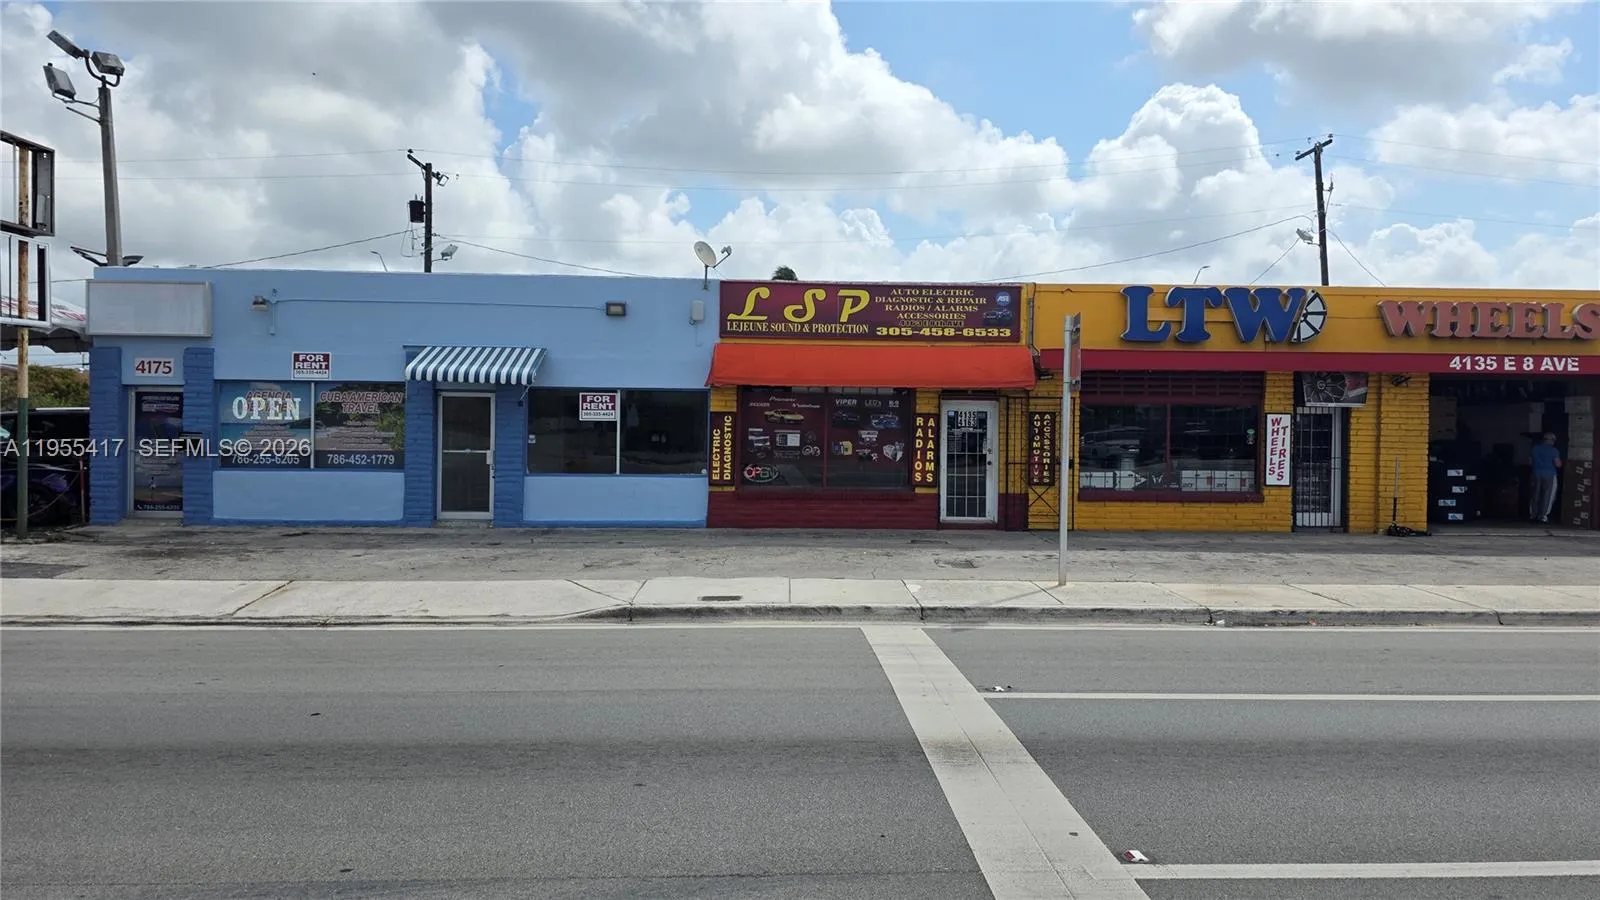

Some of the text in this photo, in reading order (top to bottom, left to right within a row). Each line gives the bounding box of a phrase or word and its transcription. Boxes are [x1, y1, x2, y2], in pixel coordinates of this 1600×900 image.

[1120, 285, 1308, 343] LTW
[1376, 300, 1600, 340] WHEELS
[727, 321, 869, 334] LEJEUNE SOUND & PROTECTION
[876, 327, 1012, 337] 305-458-6533
[135, 360, 173, 375] 4175
[299, 354, 324, 362] FOR
[1450, 356, 1580, 371] 4135 E 8 AVE
[232, 396, 302, 420] OPEN
[341, 402, 380, 414] TRAVEL
[586, 395, 610, 403] FOR
[712, 428, 721, 480] ELECTRIC
[723, 415, 732, 480] DIAGNOSTIC
[914, 417, 924, 481] RADIOS
[925, 418, 935, 482] ALARMS
[1033, 414, 1041, 483] AUTOMOTIVE
[1268, 417, 1282, 476] WHEELS
[1277, 426, 1288, 481] TIRES
[231, 453, 300, 465] 786-255-6205
[327, 454, 395, 465] 786-452-1779
